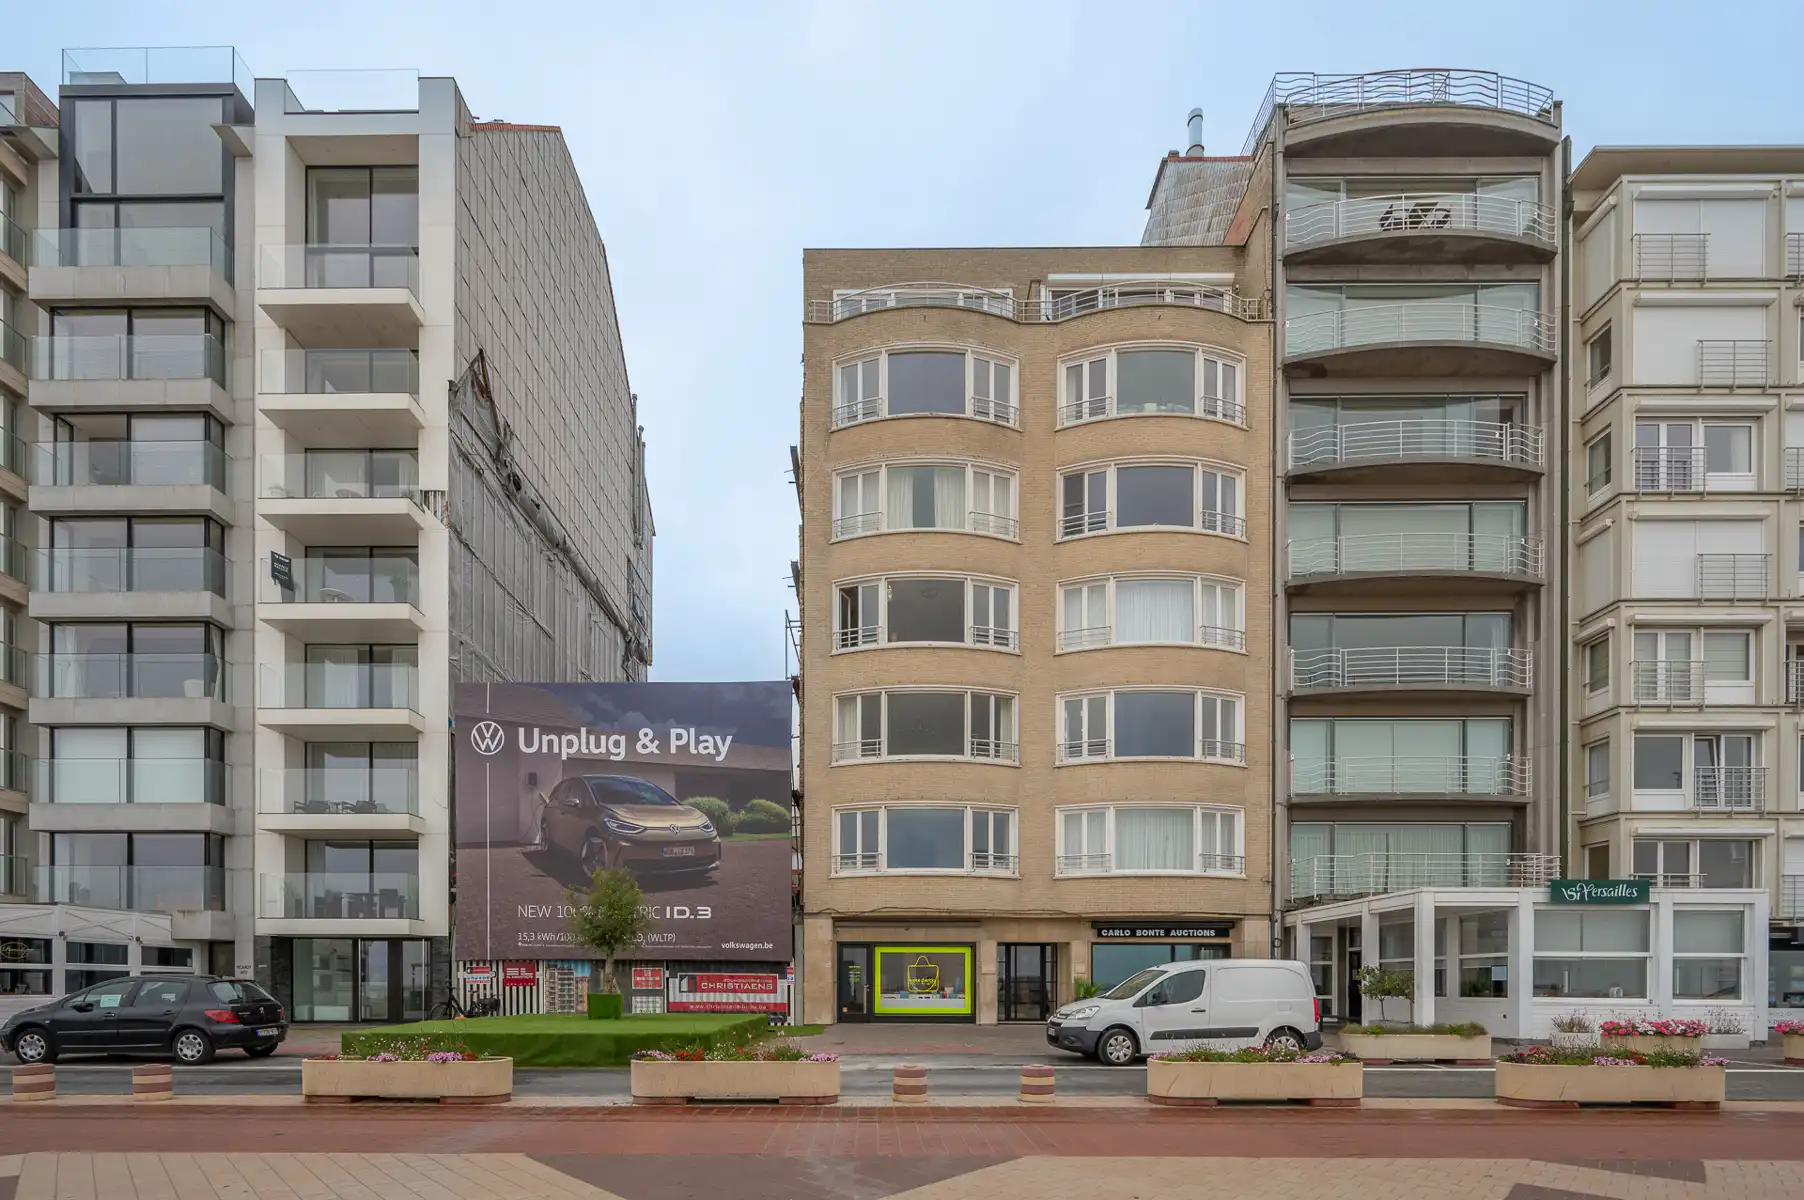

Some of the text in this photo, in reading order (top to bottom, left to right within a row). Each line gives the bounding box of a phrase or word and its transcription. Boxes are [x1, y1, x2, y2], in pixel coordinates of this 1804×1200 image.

[518, 728, 733, 761] Unplug & Play
[1576, 882, 1638, 902] Versailles
[518, 905, 552, 918] NEW
[666, 906, 712, 919] ID.3
[517, 932, 535, 942] 15,3
[647, 932, 676, 943] (WLTP)
[1101, 929, 1216, 937] CARLO BONTE AUCTIONS
[721, 941, 774, 950] volkswagen.be
[701, 982, 773, 990] CHRISTIAENS
